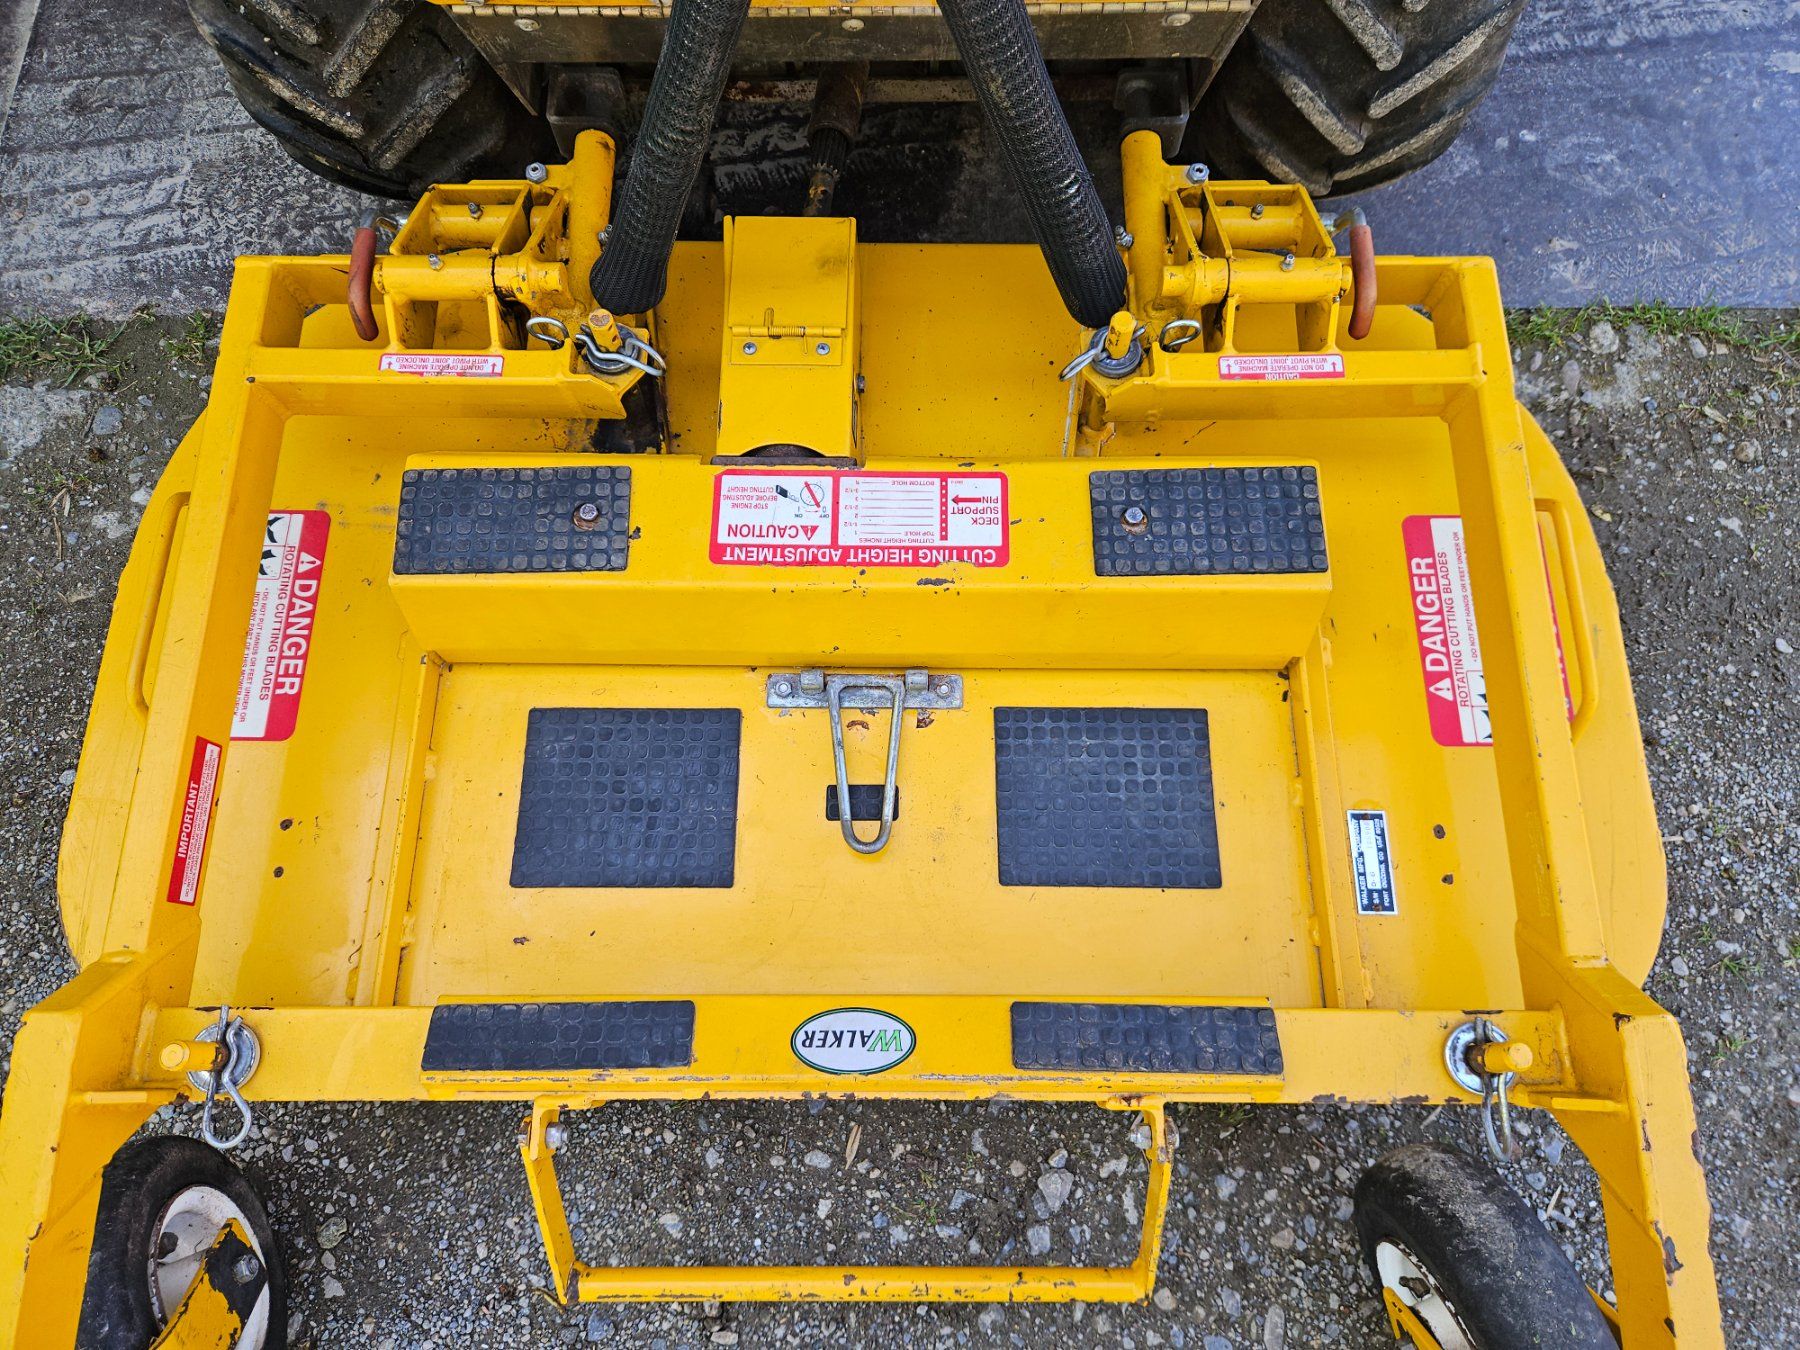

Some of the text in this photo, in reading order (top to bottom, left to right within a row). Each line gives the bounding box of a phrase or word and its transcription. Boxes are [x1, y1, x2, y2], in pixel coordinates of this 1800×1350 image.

[727, 524, 798, 538] CAUTION
[1452, 531, 1459, 540] OR
[722, 546, 995, 562] CUTTING HEIGHT ADJUSTMENT
[1454, 542, 1462, 563] UNDER
[262, 591, 267, 600] DO
[1460, 583, 1467, 591] OR
[1411, 557, 1449, 671] DANGER
[1462, 594, 1470, 616] HANDS
[259, 545, 295, 700] ROTATING CUTTING BLADES
[1437, 551, 1469, 706] ROTATING CUTTING BLADES
[251, 632, 260, 654] HANDS
[275, 579, 317, 694] DANGER
[250, 657, 255, 666] OR
[1470, 647, 1477, 657] DO
[241, 686, 250, 709] UNDER
[239, 712, 245, 721] OR
[178, 782, 199, 857] IMPORTANT
[1351, 819, 1361, 851] COMPANY
[1378, 851, 1383, 860] CO
[1359, 875, 1368, 904] WALKER
[801, 1029, 902, 1051] WALKER
